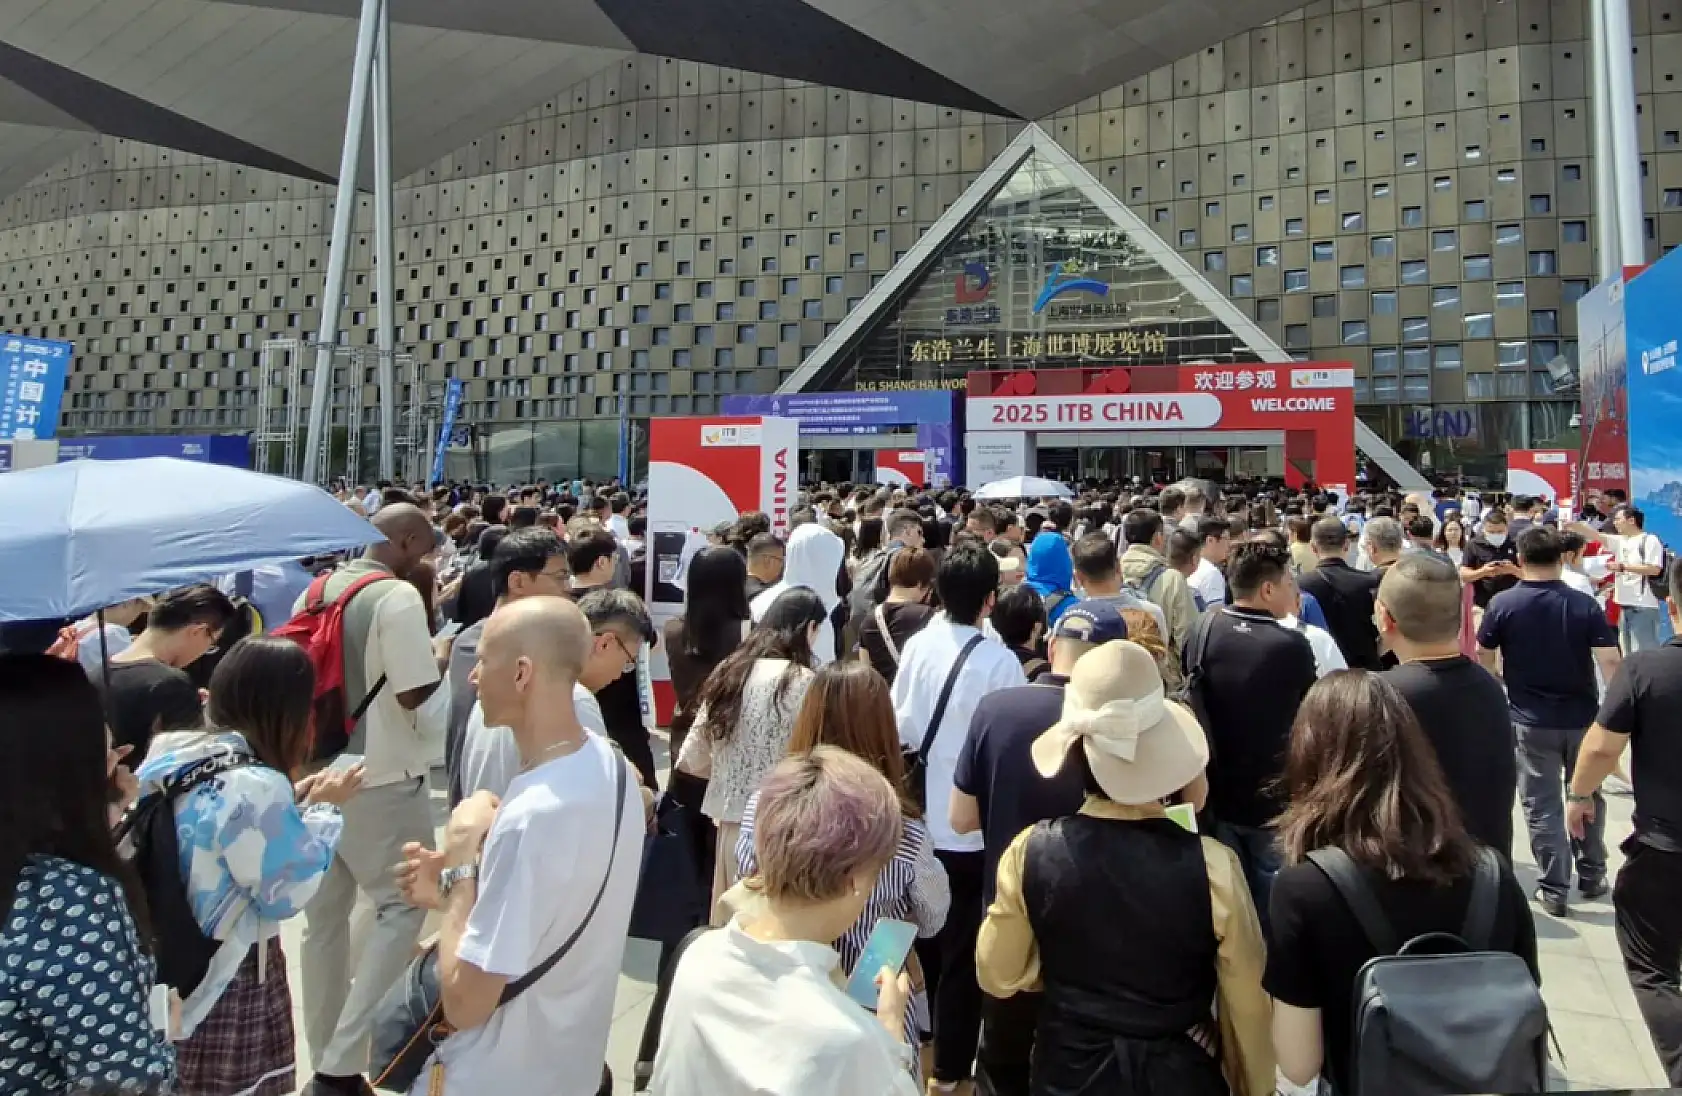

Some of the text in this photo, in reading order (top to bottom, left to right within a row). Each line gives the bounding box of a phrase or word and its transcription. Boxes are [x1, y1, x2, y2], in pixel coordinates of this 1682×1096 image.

[911, 331, 1166, 362] 东浩兰生上海世博展览馆
[878, 380, 915, 391] SHANG
[1194, 370, 1276, 390] 欢迎参观
[992, 400, 1183, 424] 2025 ITB CHINA
[1250, 397, 1335, 412] WELCOME
